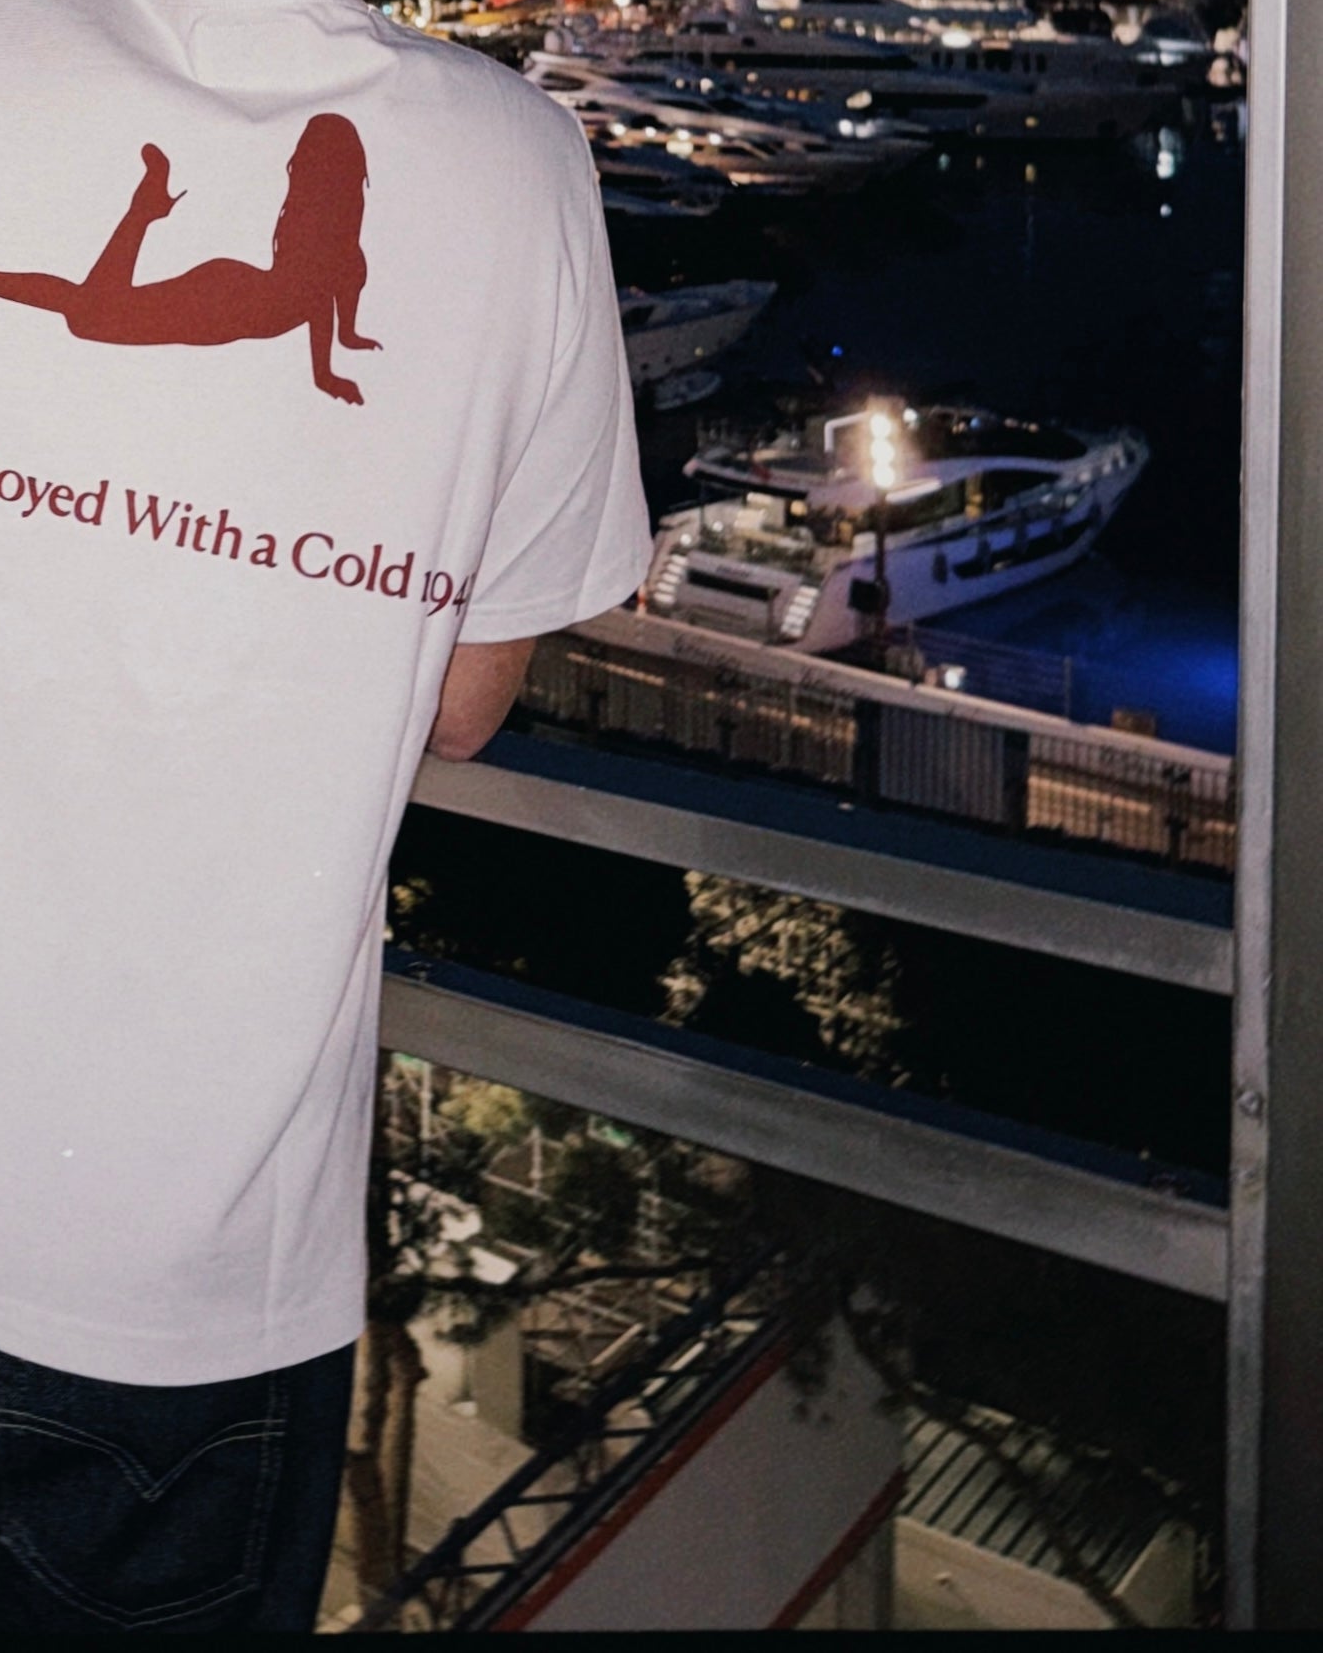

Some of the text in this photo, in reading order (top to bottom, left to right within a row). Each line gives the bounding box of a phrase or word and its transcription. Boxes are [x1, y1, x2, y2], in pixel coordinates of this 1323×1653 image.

[125, 488, 243, 560] With
[249, 533, 278, 569] a
[291, 532, 416, 599] Cold
[420, 570, 477, 618] 194
